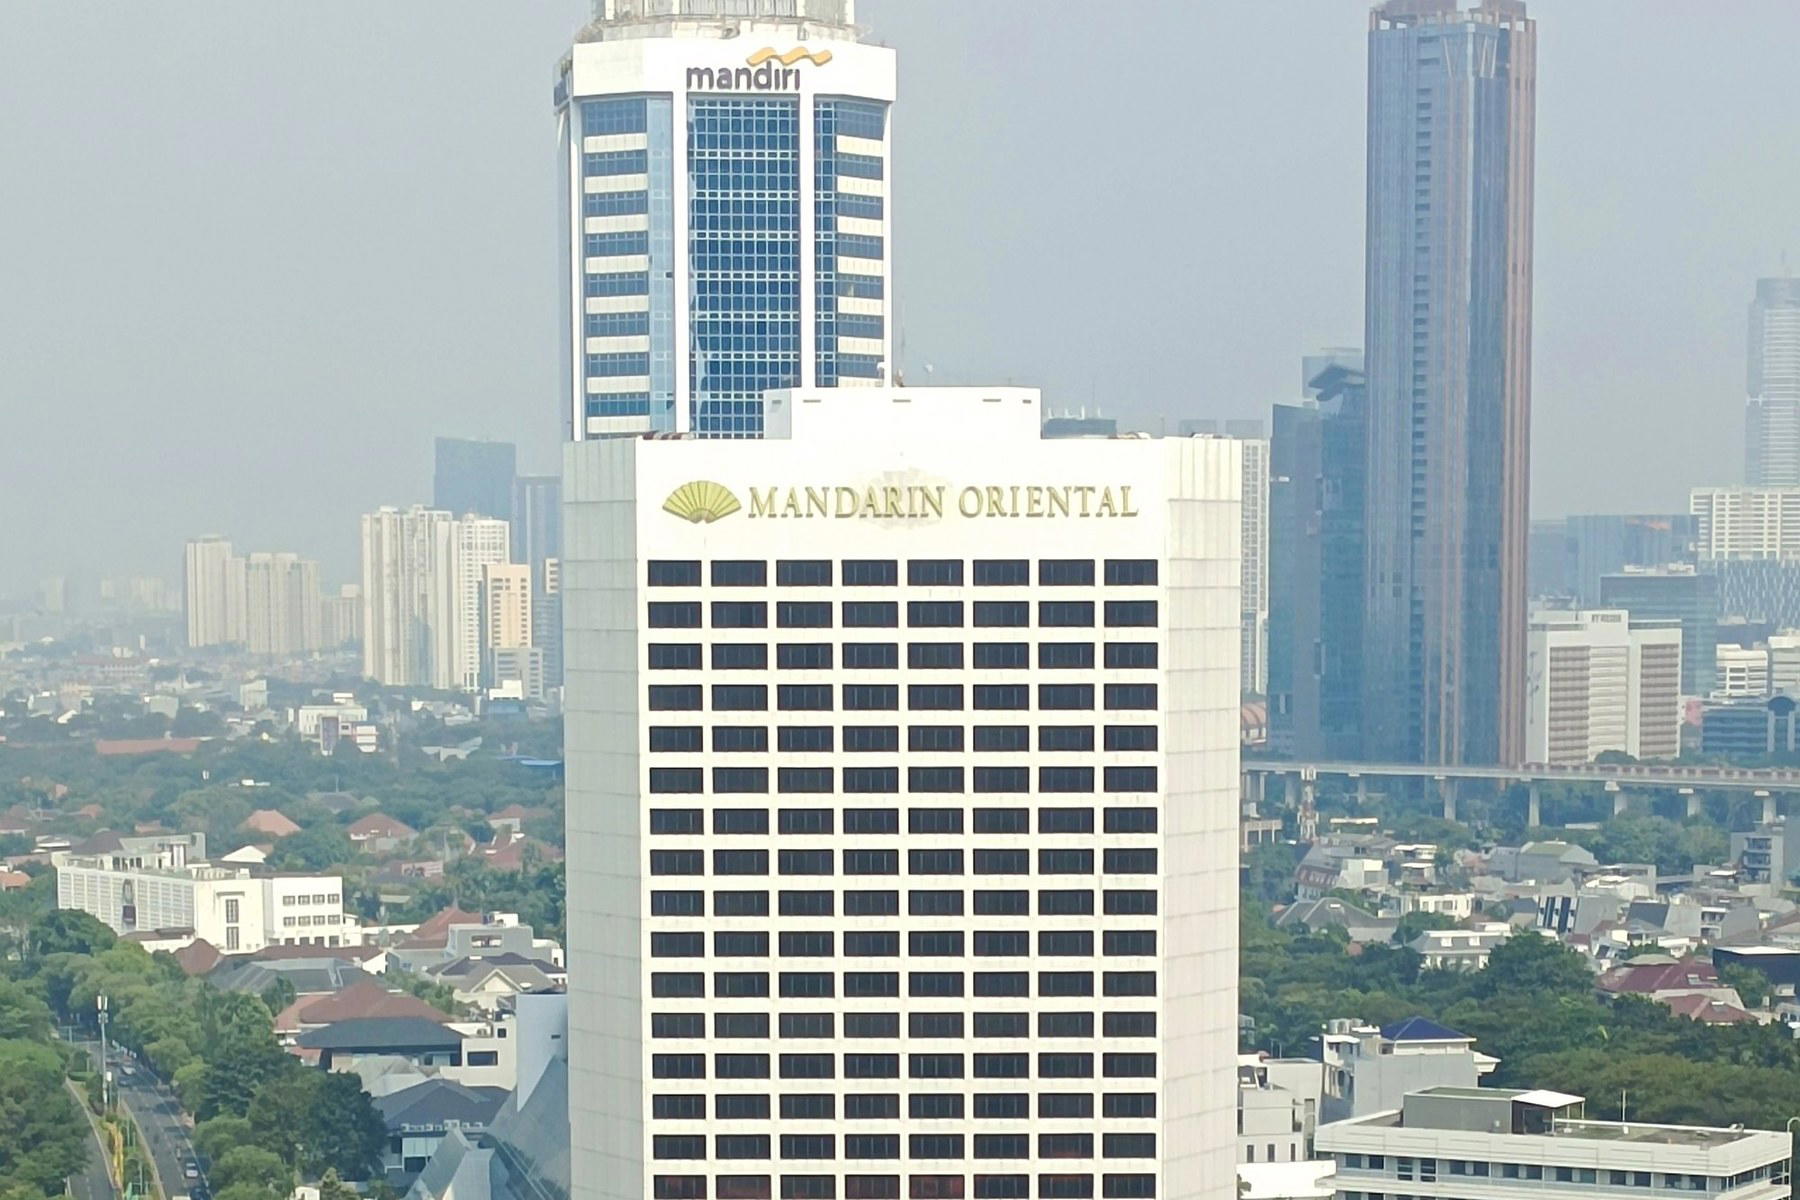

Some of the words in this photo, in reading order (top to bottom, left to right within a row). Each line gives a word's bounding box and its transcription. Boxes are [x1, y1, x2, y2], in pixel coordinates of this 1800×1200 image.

[687, 61, 800, 90] mandiri
[748, 485, 946, 518] MANDARIN
[958, 485, 1139, 518] ORIENTAL
